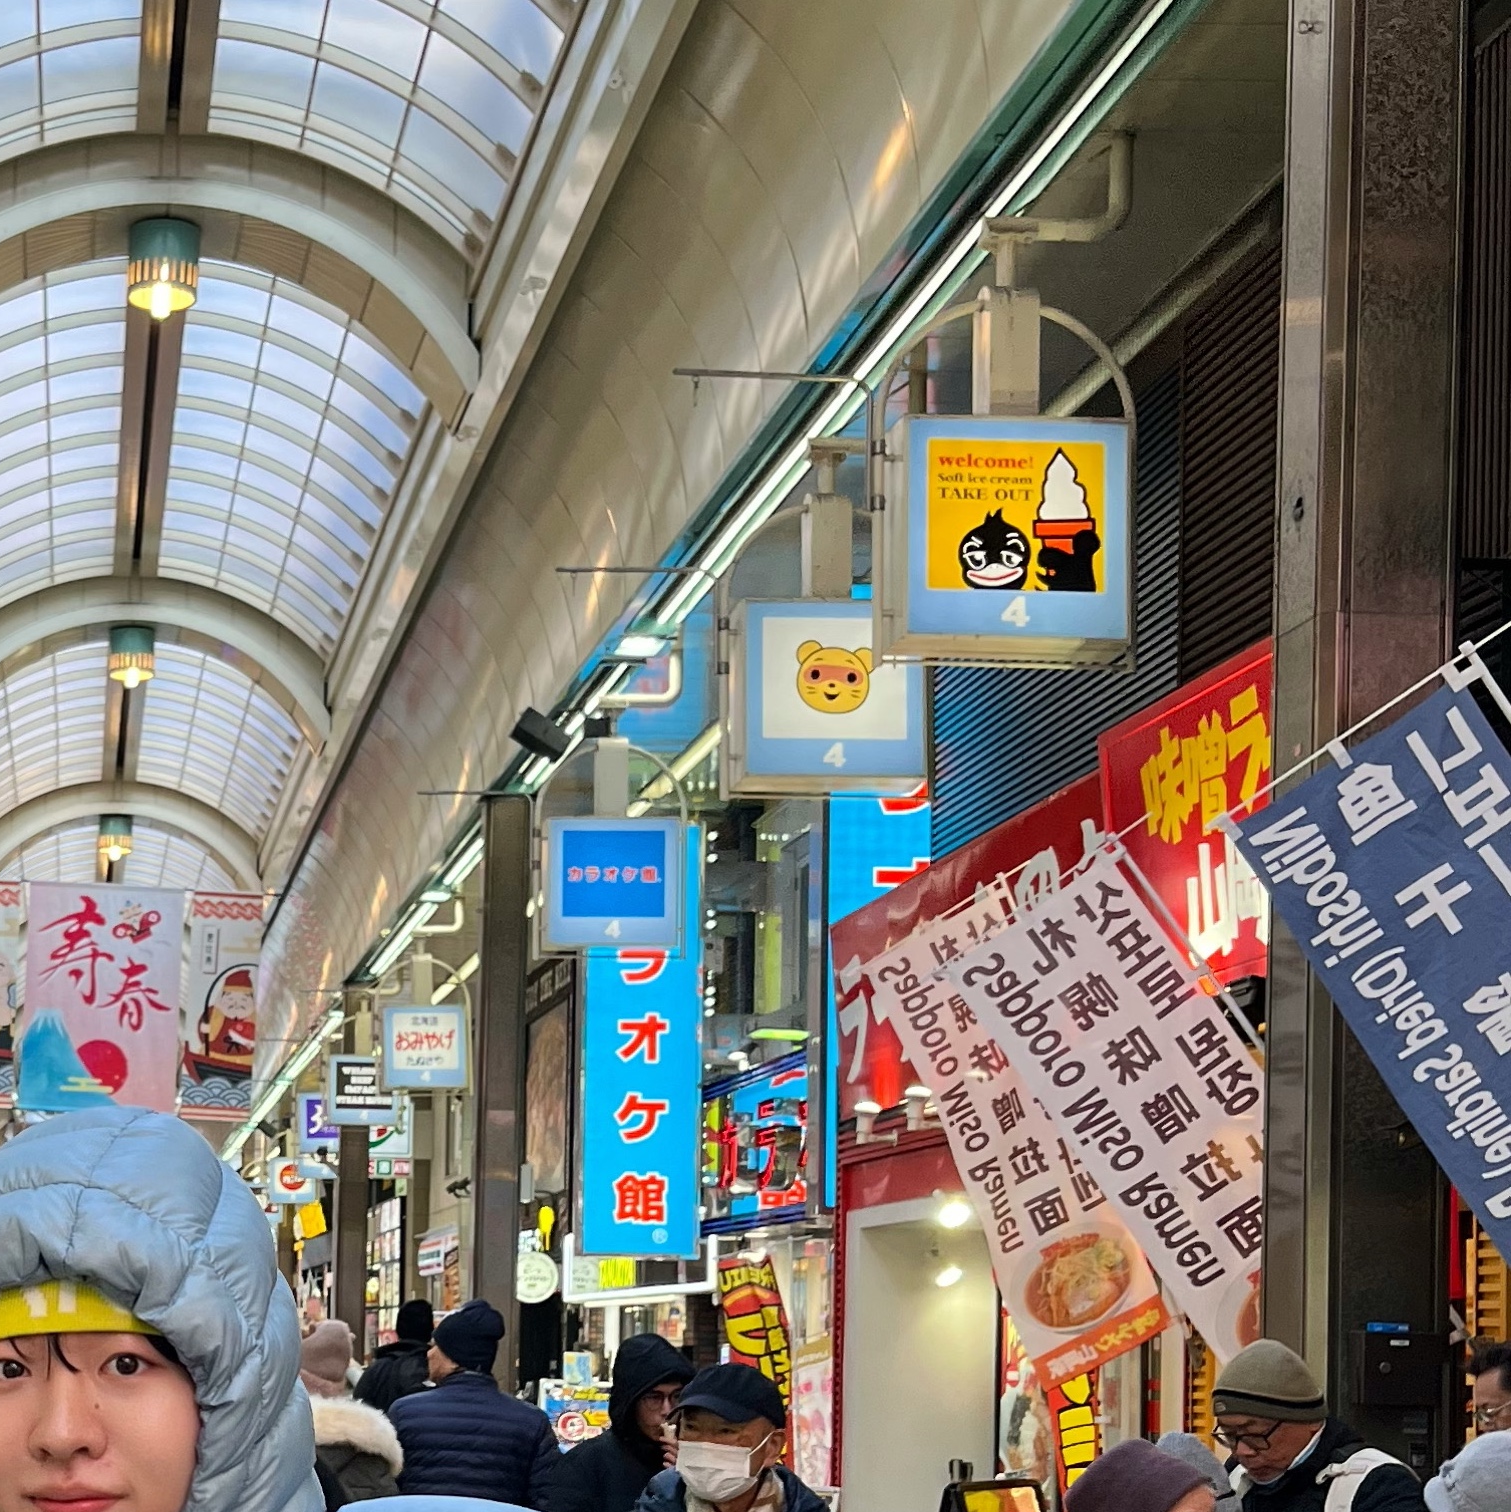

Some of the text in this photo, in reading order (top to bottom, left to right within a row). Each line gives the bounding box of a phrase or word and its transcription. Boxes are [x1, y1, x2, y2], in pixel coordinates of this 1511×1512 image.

[938, 453, 1034, 470] welcome!
[938, 472, 1033, 485] Soft ice cream
[938, 487, 1034, 501] TAKE OUT
[1001, 596, 1030, 627] 4
[823, 742, 846, 767] 4
[1140, 683, 1270, 844] 味噌ラ
[604, 920, 621, 938] 4
[395, 1029, 455, 1051] おみやげ
[420, 1071, 431, 1082] 4
